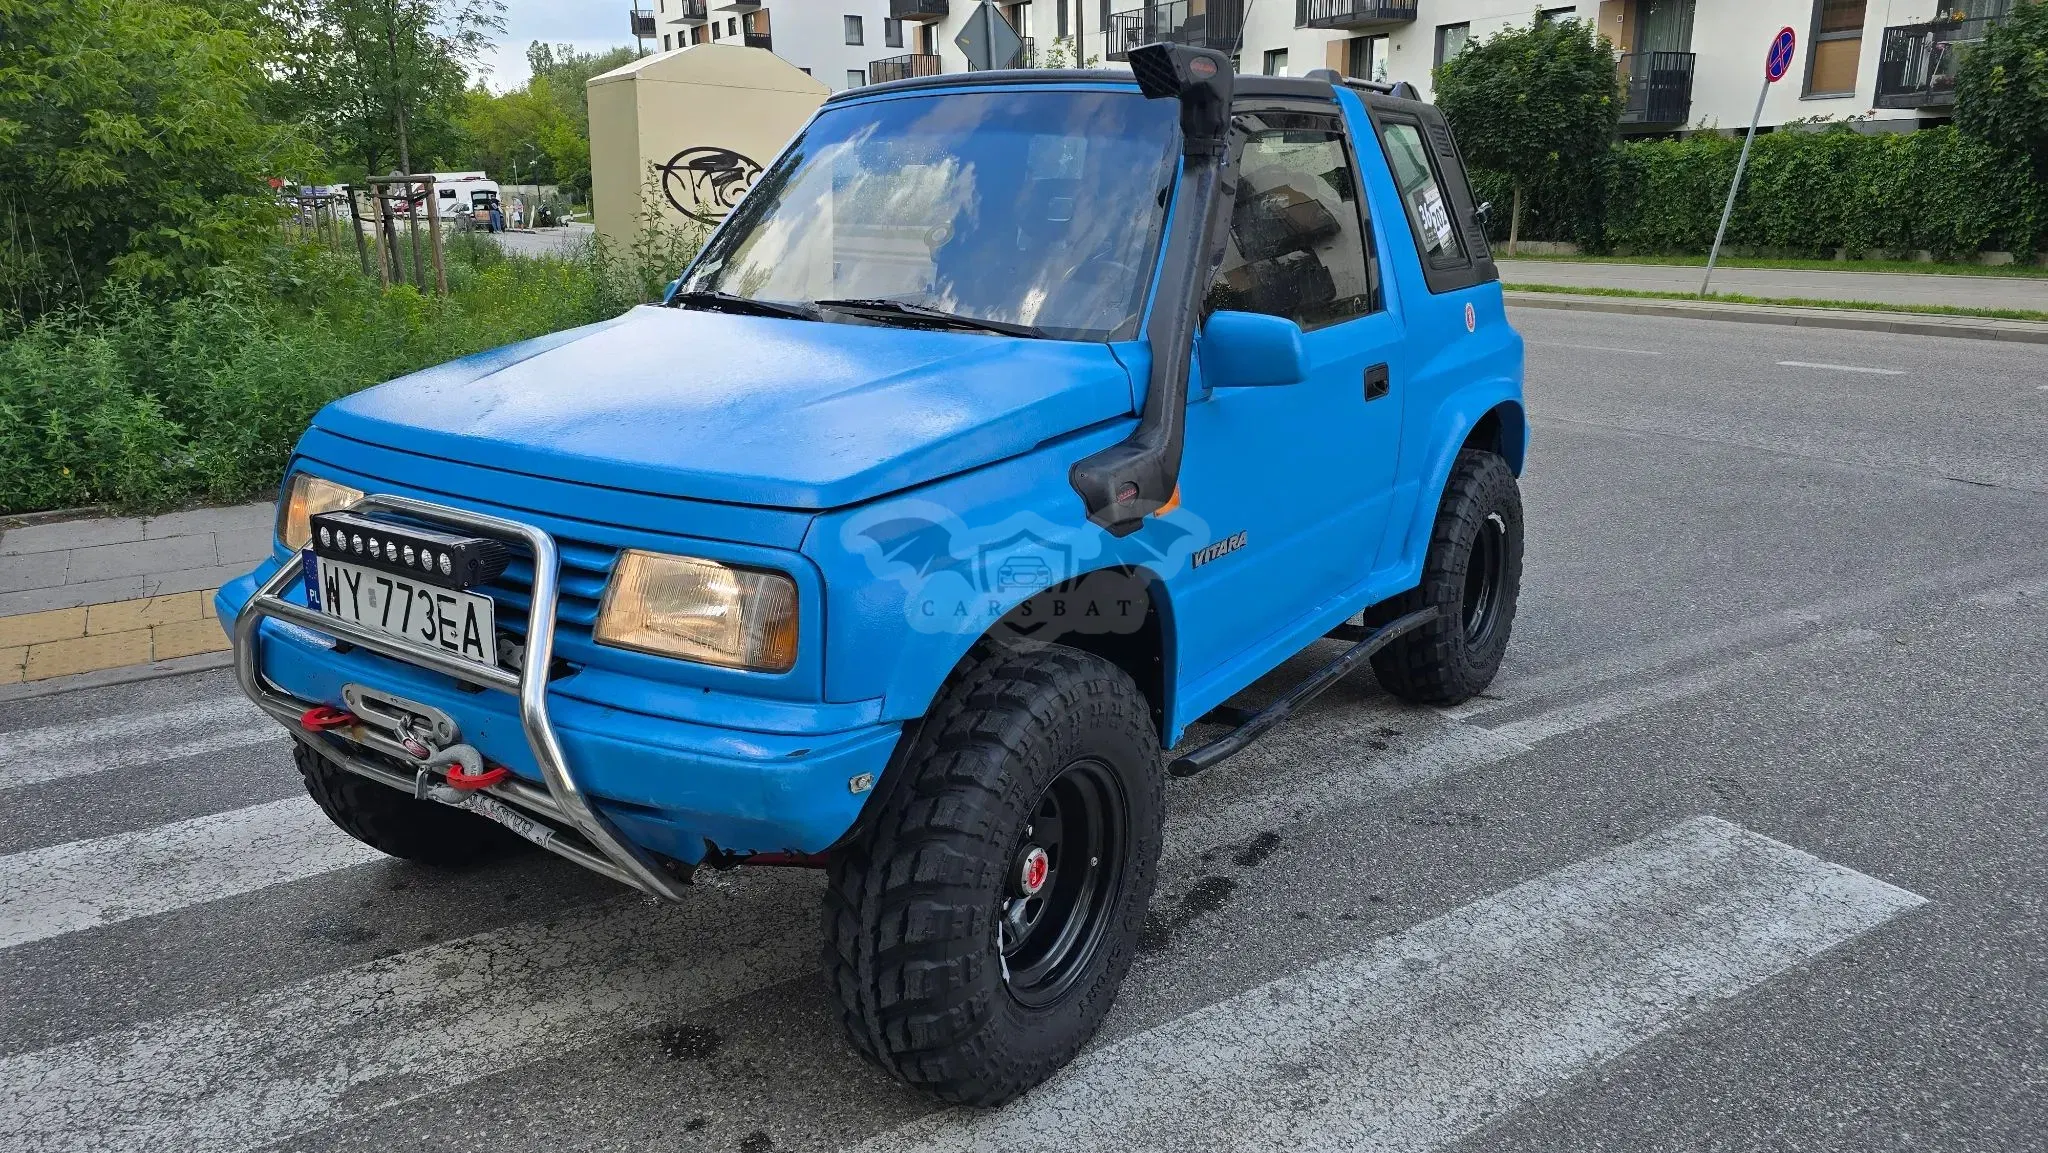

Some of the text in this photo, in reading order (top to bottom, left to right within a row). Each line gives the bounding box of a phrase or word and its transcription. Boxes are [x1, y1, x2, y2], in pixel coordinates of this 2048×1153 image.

[1192, 529, 1248, 570] VITARA
[309, 588, 321, 604] PL
[322, 562, 484, 659] WY 773EA
